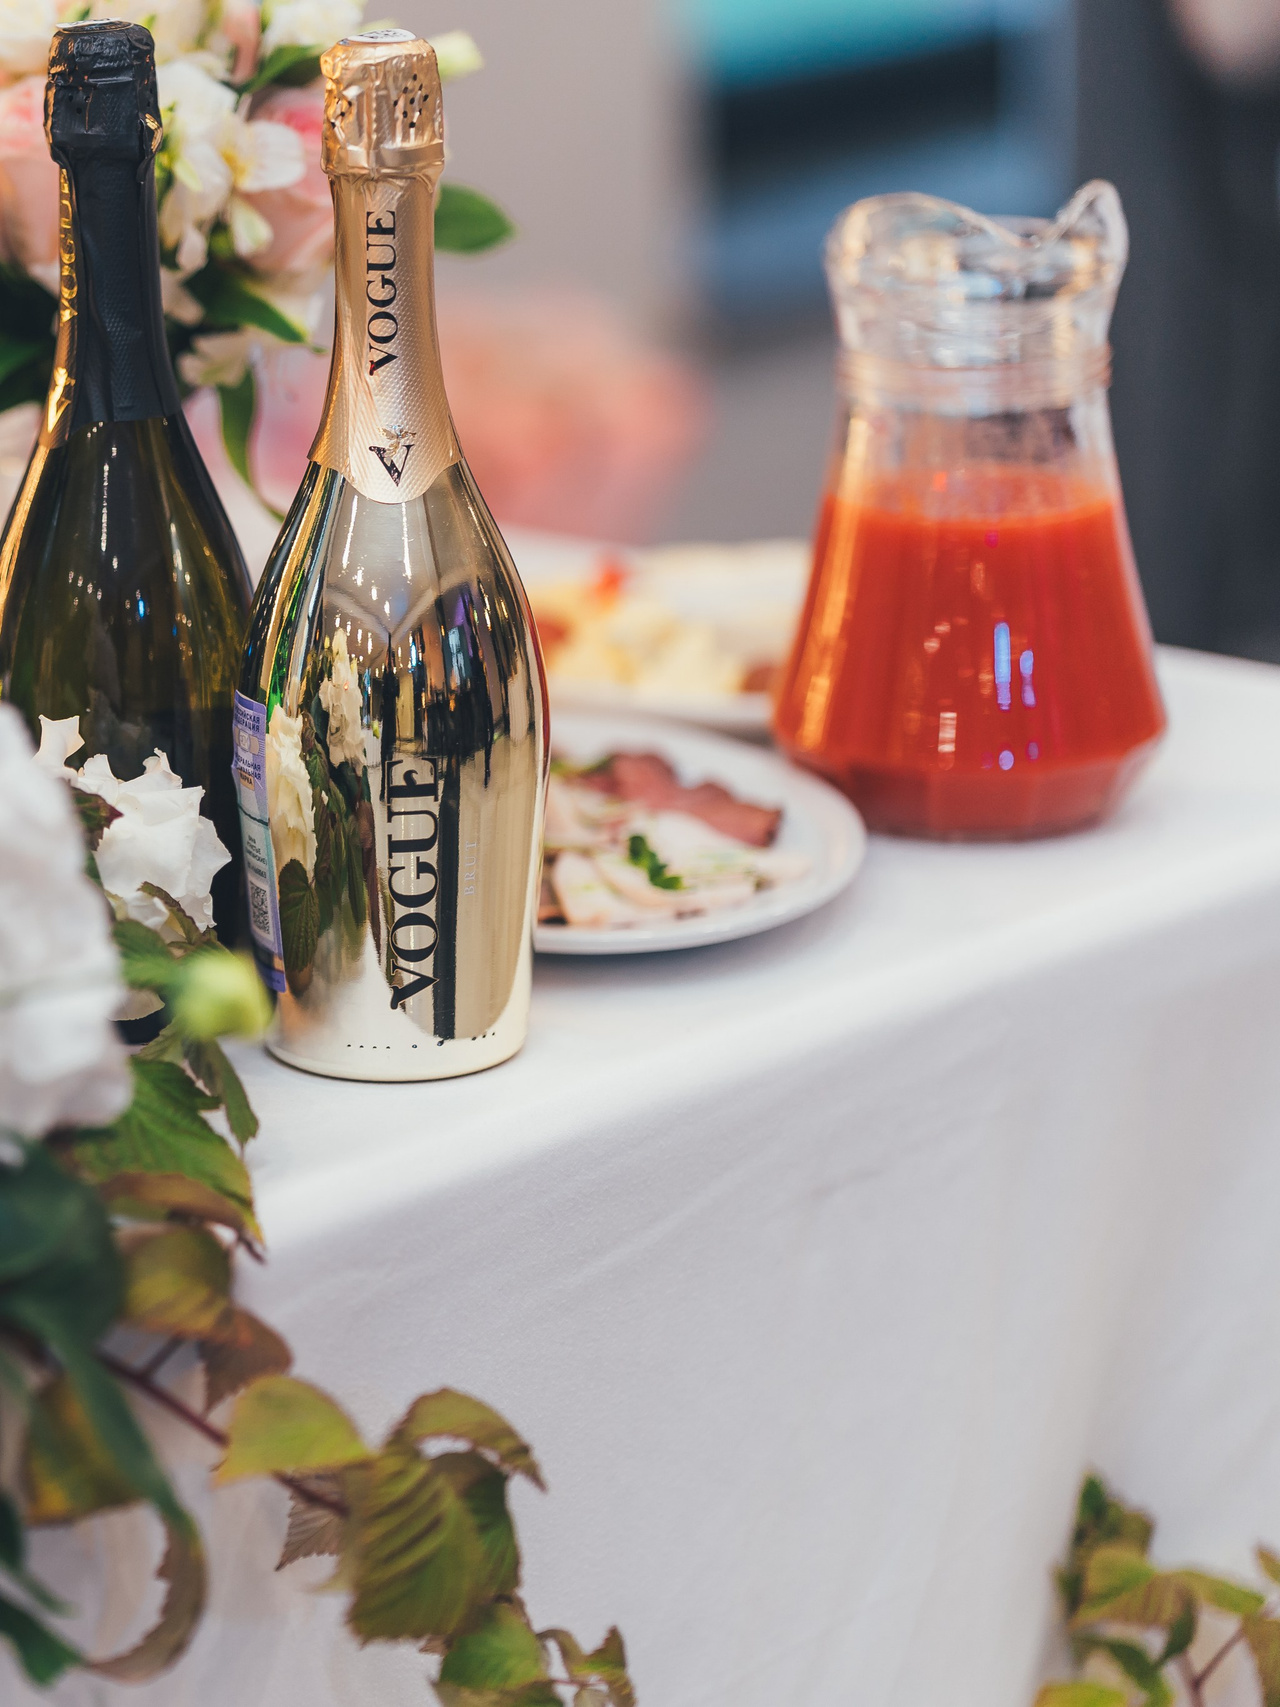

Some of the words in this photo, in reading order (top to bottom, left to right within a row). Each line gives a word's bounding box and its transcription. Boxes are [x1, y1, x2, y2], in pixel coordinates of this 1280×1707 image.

[366, 209, 399, 376] VOGUE
[385, 757, 440, 1010] VOGUE
[464, 840, 478, 896] BRUT
